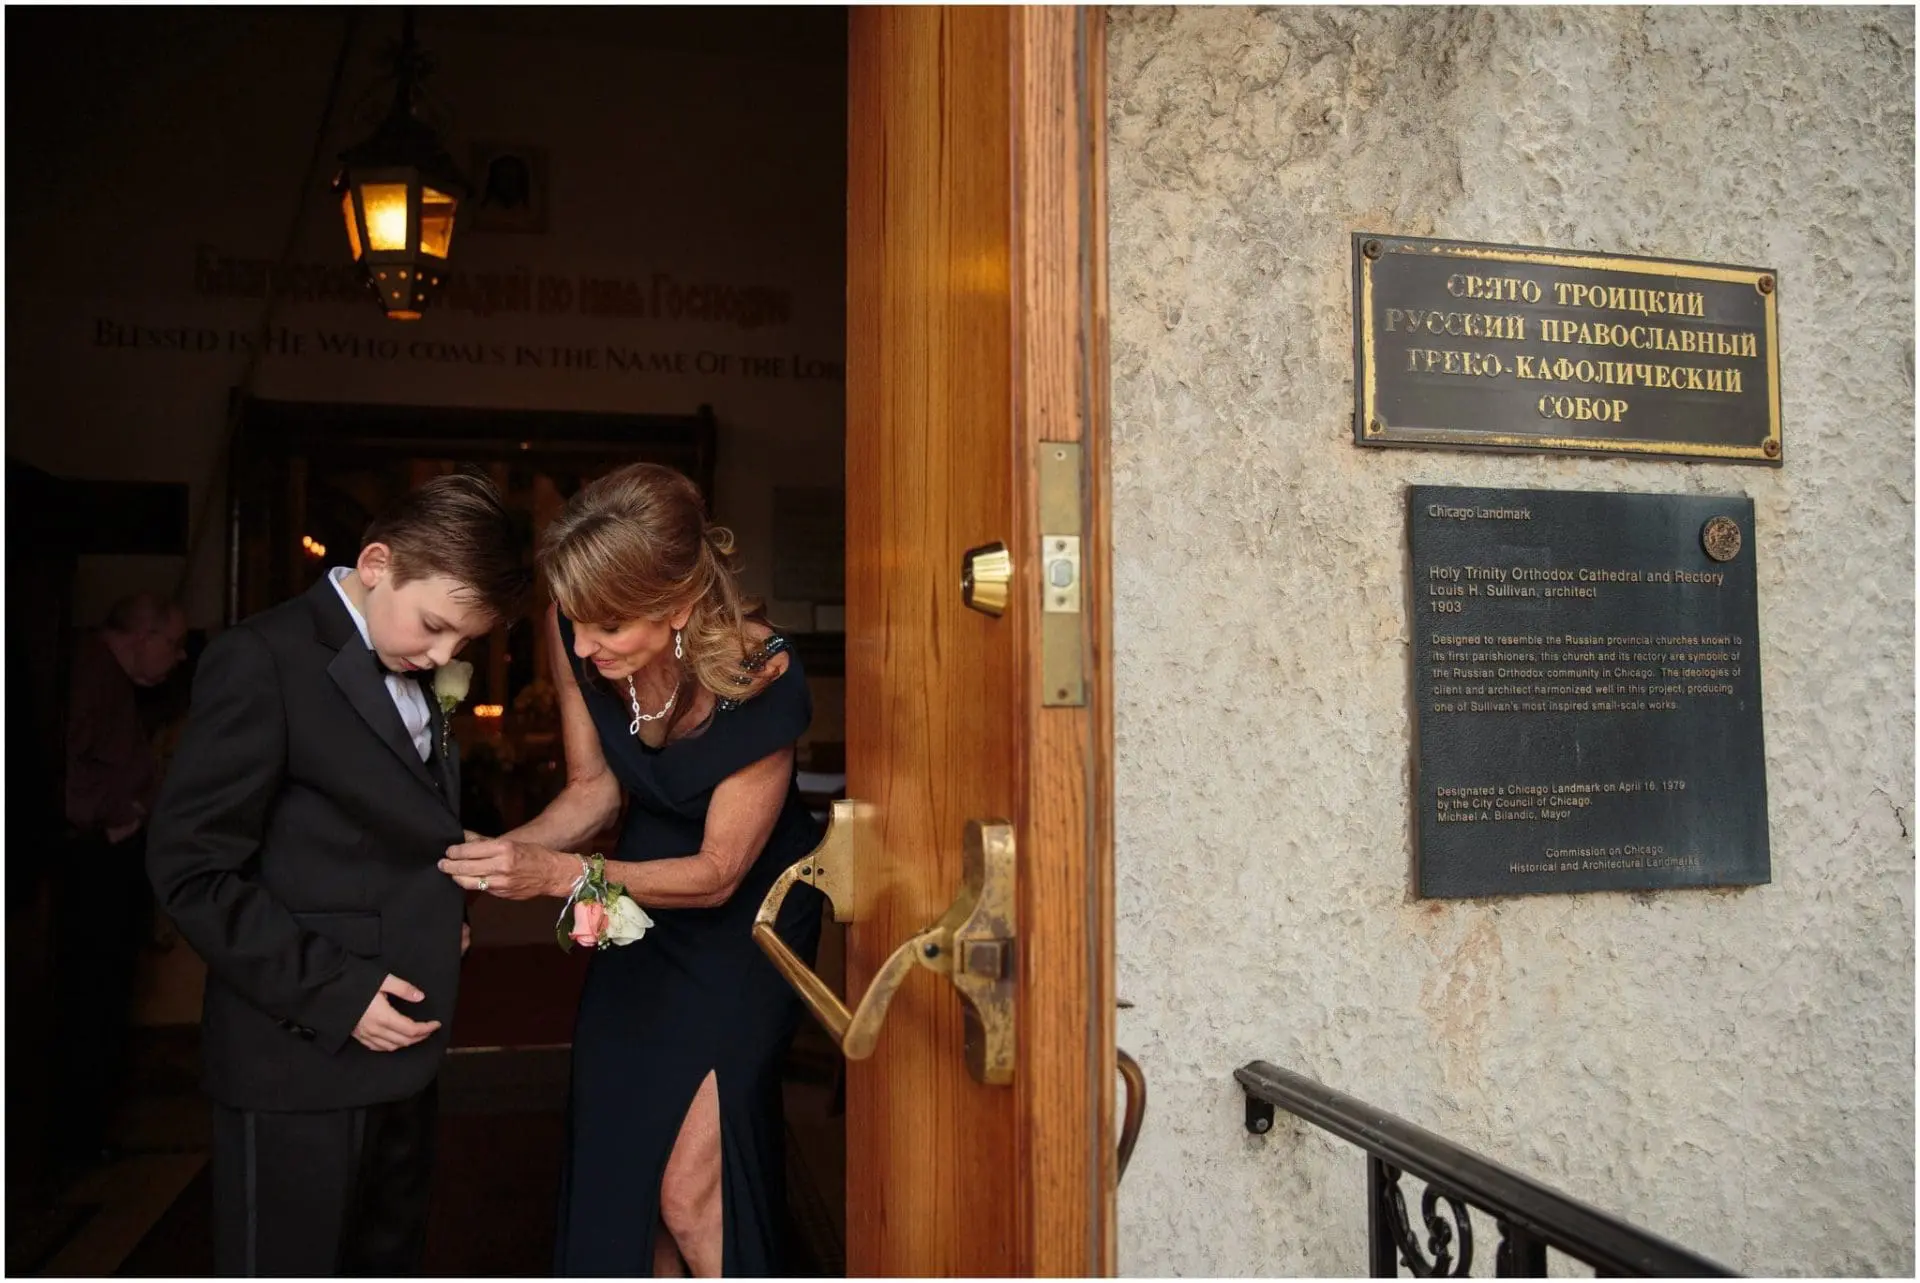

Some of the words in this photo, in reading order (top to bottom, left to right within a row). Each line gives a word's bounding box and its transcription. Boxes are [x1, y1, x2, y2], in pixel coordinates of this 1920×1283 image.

[1447, 273, 1542, 303] СВЯТО
[1554, 282, 1705, 317] ТРОИЦКИЙ
[1385, 308, 1525, 340] РУССКИЙ
[1540, 319, 1758, 358] ПРАВОСЛАВНЫЙ
[1407, 349, 1743, 393] ГРЕКО-КАФОЛИЧЕСКИЙ
[1538, 395, 1628, 423] СОБОР
[1428, 505, 1474, 520] Chicago
[1477, 507, 1531, 520] Landmark
[1429, 566, 1460, 581] Holy
[1465, 566, 1507, 582] Trinity
[1512, 566, 1574, 581] Orthodox
[1578, 568, 1642, 583] Cathedral
[1647, 570, 1670, 583] and
[1675, 570, 1724, 586] Rectory
[1429, 584, 1464, 596] Louis
[1544, 585, 1597, 598] architect
[1431, 601, 1462, 613] 1903
[1432, 634, 1481, 647] Designed
[1484, 635, 1494, 645] to
[1497, 635, 1542, 645] resemble
[1546, 635, 1561, 645] the
[1565, 635, 1604, 645] Russian
[1607, 635, 1652, 647] provincial
[1655, 635, 1698, 645] churches
[1701, 635, 1730, 645] known
[1733, 636, 1742, 645] to
[1432, 652, 1445, 661] its
[1448, 651, 1468, 661] first
[1472, 651, 1537, 664] parishioners,
[1541, 652, 1559, 661] this
[1562, 651, 1595, 661] church
[1599, 651, 1616, 661] and
[1618, 652, 1630, 661] its
[1633, 652, 1667, 663] rectory
[1670, 653, 1685, 661] are
[1688, 651, 1728, 664] symbolic
[1731, 651, 1740, 661] of
[1433, 668, 1449, 678] the
[1453, 668, 1494, 678] Russian
[1498, 668, 1544, 678] Orthodox
[1547, 668, 1599, 679] community
[1602, 668, 1611, 677] in
[1614, 667, 1655, 680] Chicago.
[1661, 667, 1679, 677] The
[1681, 668, 1729, 680] ideologies
[1732, 667, 1741, 677] of
[1433, 685, 1463, 695] client
[1466, 685, 1484, 695] and
[1488, 685, 1531, 695] architect
[1534, 685, 1592, 695] harmonized
[1595, 685, 1614, 694] well
[1616, 685, 1626, 694] in
[1628, 685, 1645, 694] this
[1648, 684, 1685, 696] project,
[1687, 684, 1734, 695] producing
[1434, 703, 1453, 712] one
[1457, 702, 1467, 712] of
[1471, 701, 1519, 712] Sullivan's
[1522, 702, 1546, 711] most
[1551, 702, 1588, 713] inspired
[1592, 701, 1645, 711] small-scale
[1437, 786, 1494, 798] Designated
[1508, 784, 1548, 796] Chicago
[1552, 783, 1600, 794] Landmark
[1603, 783, 1616, 792] on
[1619, 781, 1640, 793] April
[1662, 780, 1686, 791] 1979
[1437, 800, 1449, 811] by
[1453, 799, 1469, 809] the
[1472, 798, 1493, 810] City
[1495, 797, 1533, 808] Council
[1537, 796, 1546, 806] of
[1549, 796, 1593, 808] Chicago.
[1438, 812, 1477, 822] Michael
[1495, 810, 1537, 821] Bilandic,
[1541, 809, 1571, 821] Mayor
[1546, 847, 1605, 858] Commission
[1609, 847, 1621, 856] on
[1624, 844, 1663, 856] Chicago
[1510, 862, 1557, 873] Historical
[1561, 861, 1579, 872] and
[1582, 859, 1643, 870] Architectural
[1646, 854, 1700, 868] Landmarks
